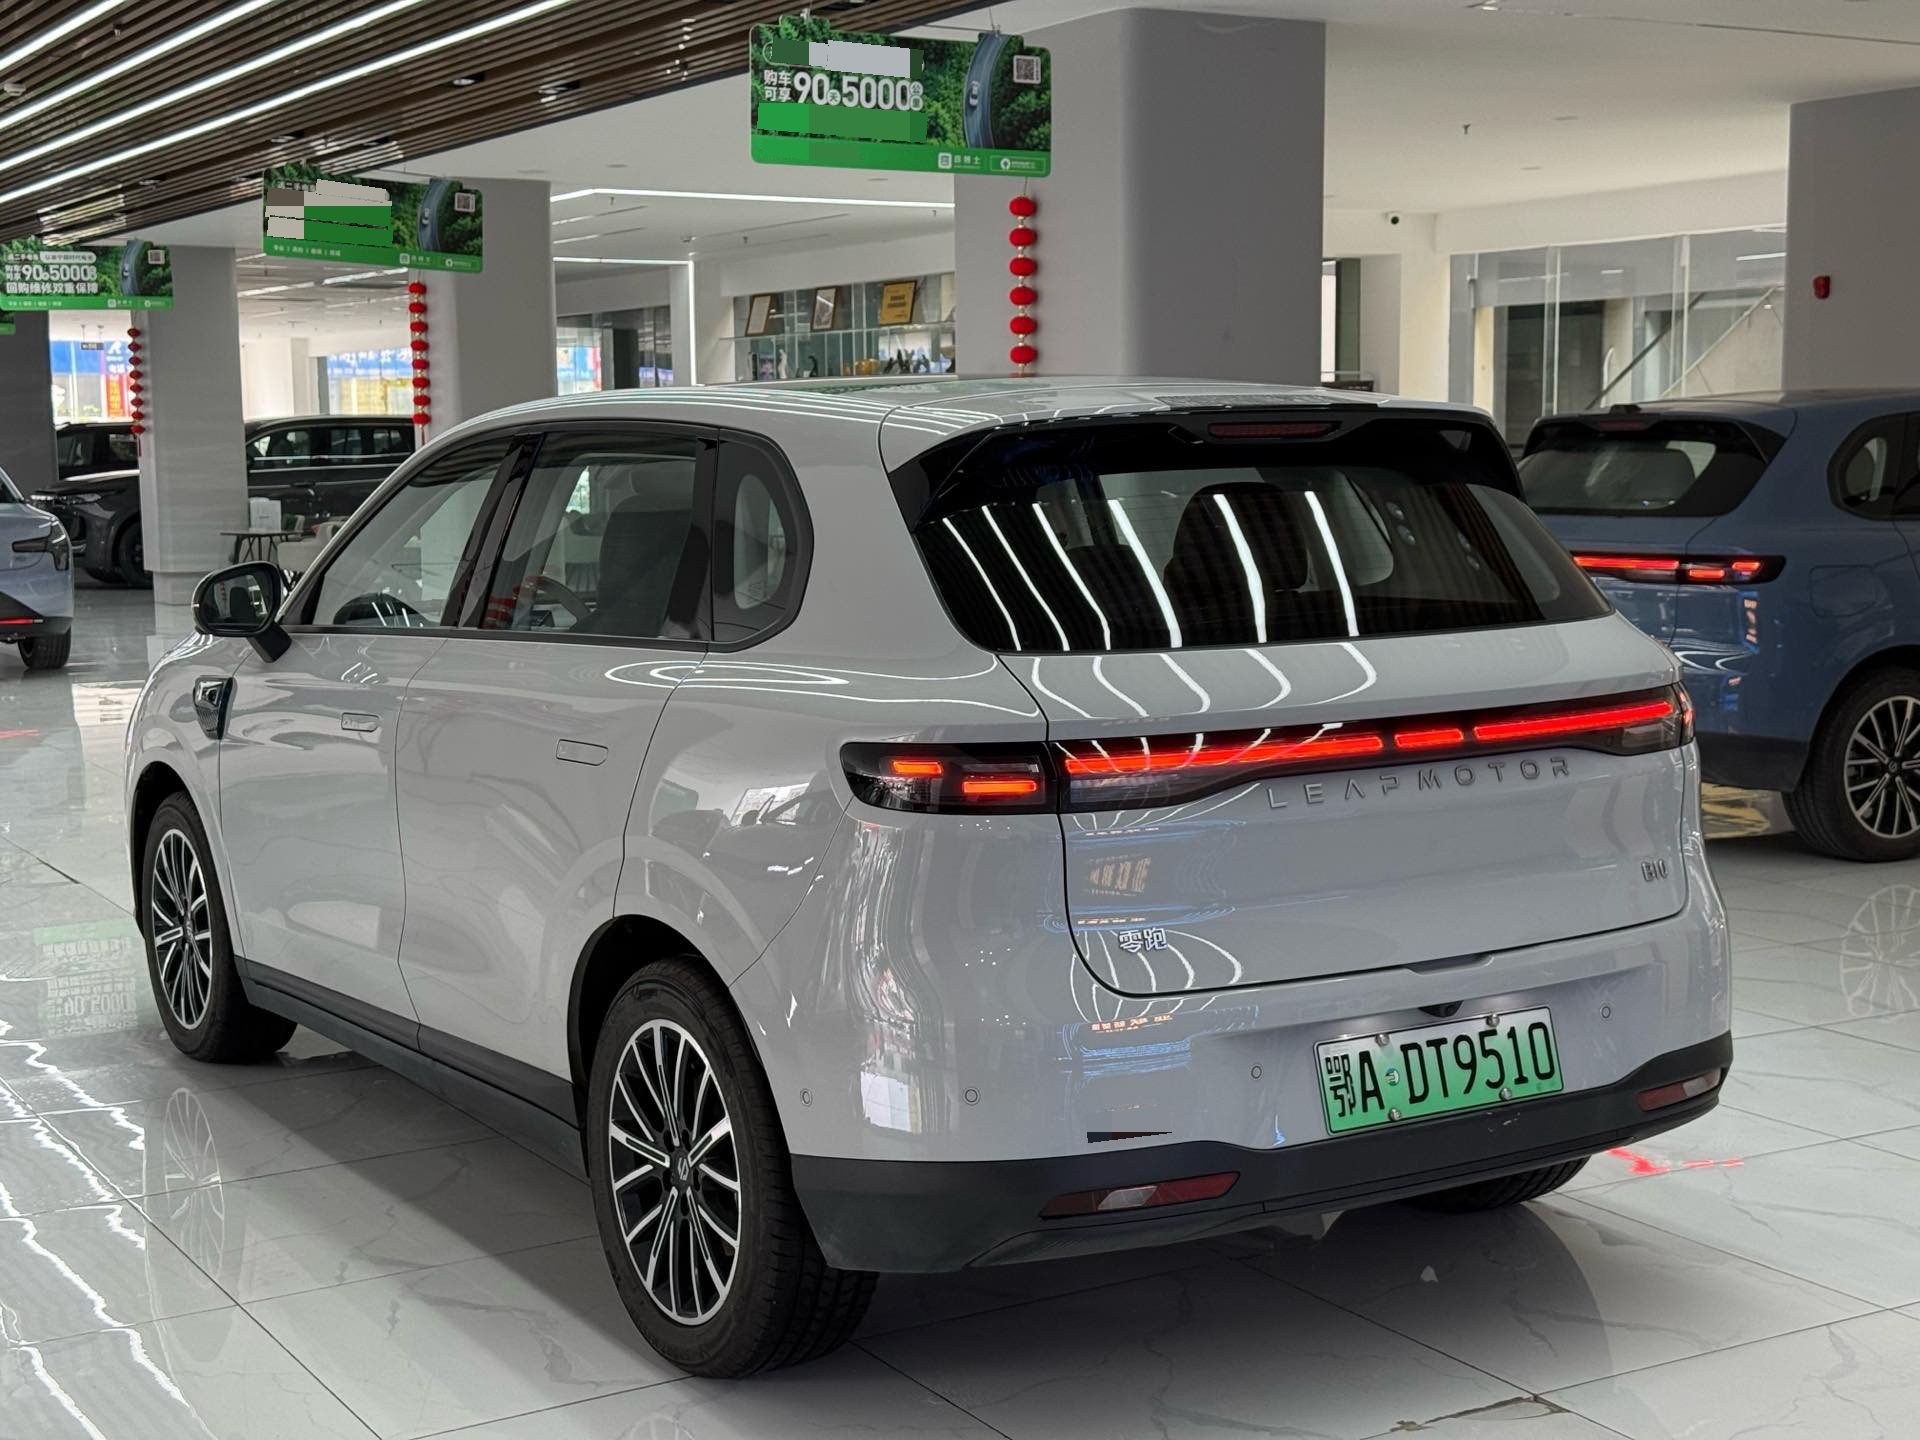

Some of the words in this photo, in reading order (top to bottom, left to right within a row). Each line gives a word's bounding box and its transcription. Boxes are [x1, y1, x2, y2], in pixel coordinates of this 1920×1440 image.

[763, 69, 792, 86] 购车
[764, 86, 792, 102] 可享
[1266, 756, 1571, 810] LEAPMOTOR
[1118, 927, 1169, 953] 零跑
[1399, 1021, 1557, 1105] DT9510
